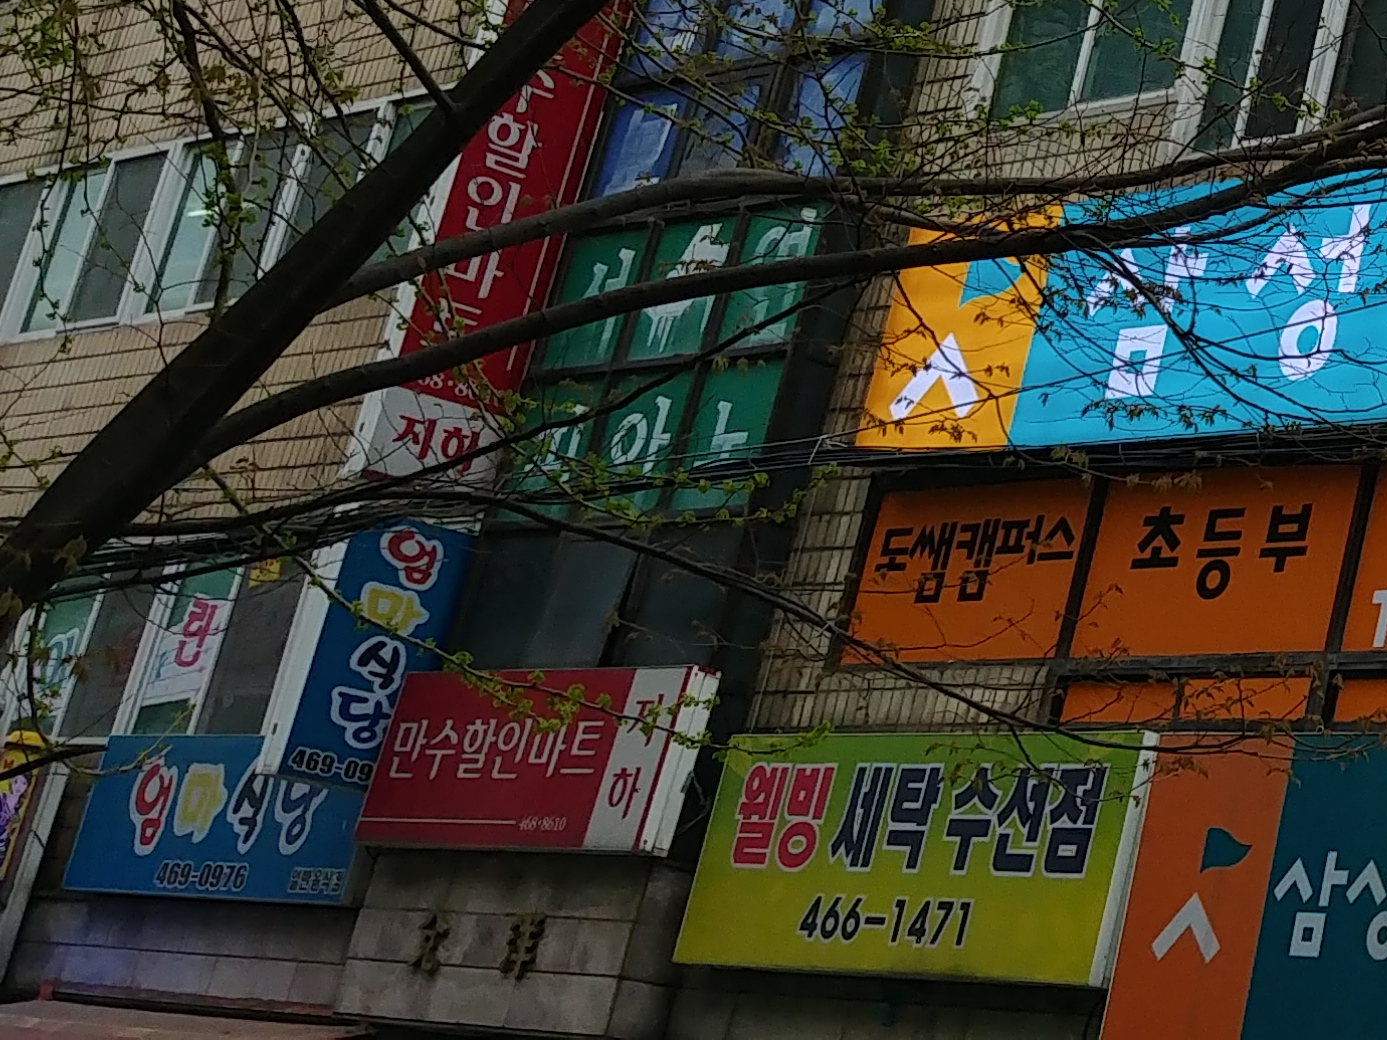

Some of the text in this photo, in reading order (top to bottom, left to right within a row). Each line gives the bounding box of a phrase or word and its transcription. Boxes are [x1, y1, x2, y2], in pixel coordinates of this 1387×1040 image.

[874, 513, 1076, 605] 도쌤캠퍼스
[1129, 502, 1314, 600] 초등부
[331, 525, 445, 750] 엄마식당
[288, 746, 376, 785] 469-09
[388, 715, 606, 781] 만수할인마트
[731, 761, 1109, 880] 웰빙 세탁 수선점
[155, 860, 250, 892] 469-0976
[798, 892, 975, 950] 466-1471
